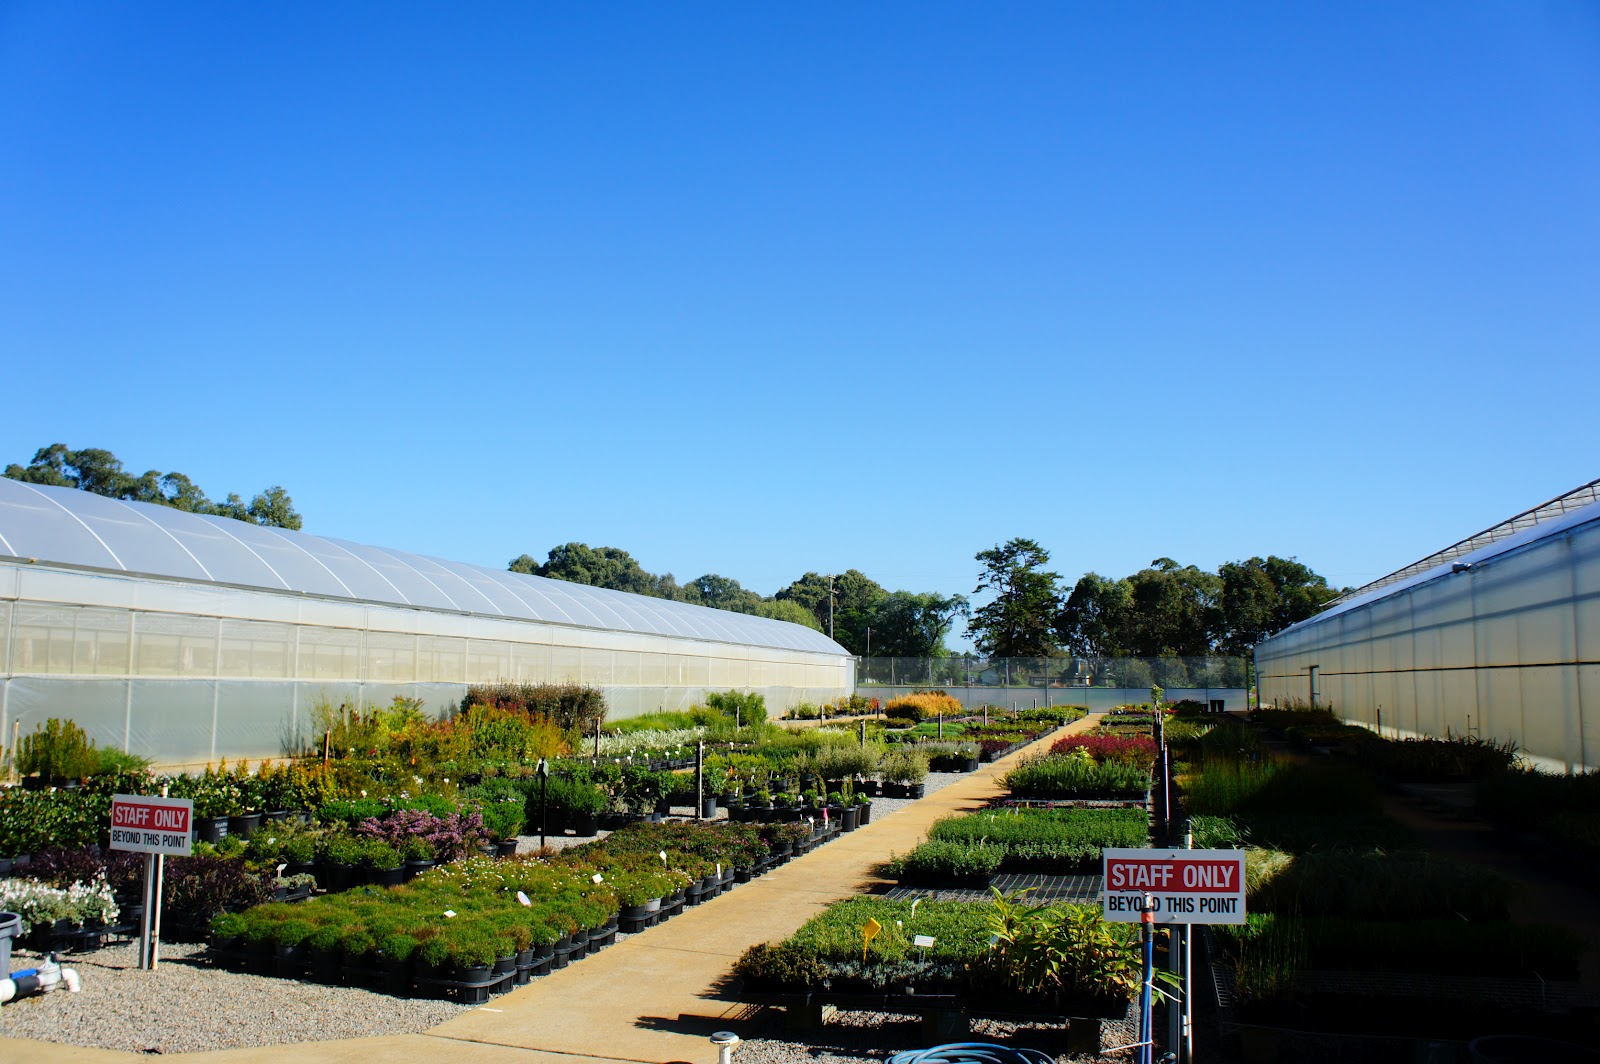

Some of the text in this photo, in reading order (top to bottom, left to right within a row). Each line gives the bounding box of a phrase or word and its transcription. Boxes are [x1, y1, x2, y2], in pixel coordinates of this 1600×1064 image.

[115, 806, 185, 828] STAFF ONLY
[112, 830, 186, 848] BEYOND THIS POINT
[1111, 864, 1234, 888] STAFF ONLY
[1109, 896, 1238, 913] BEYOD THIS POINT
